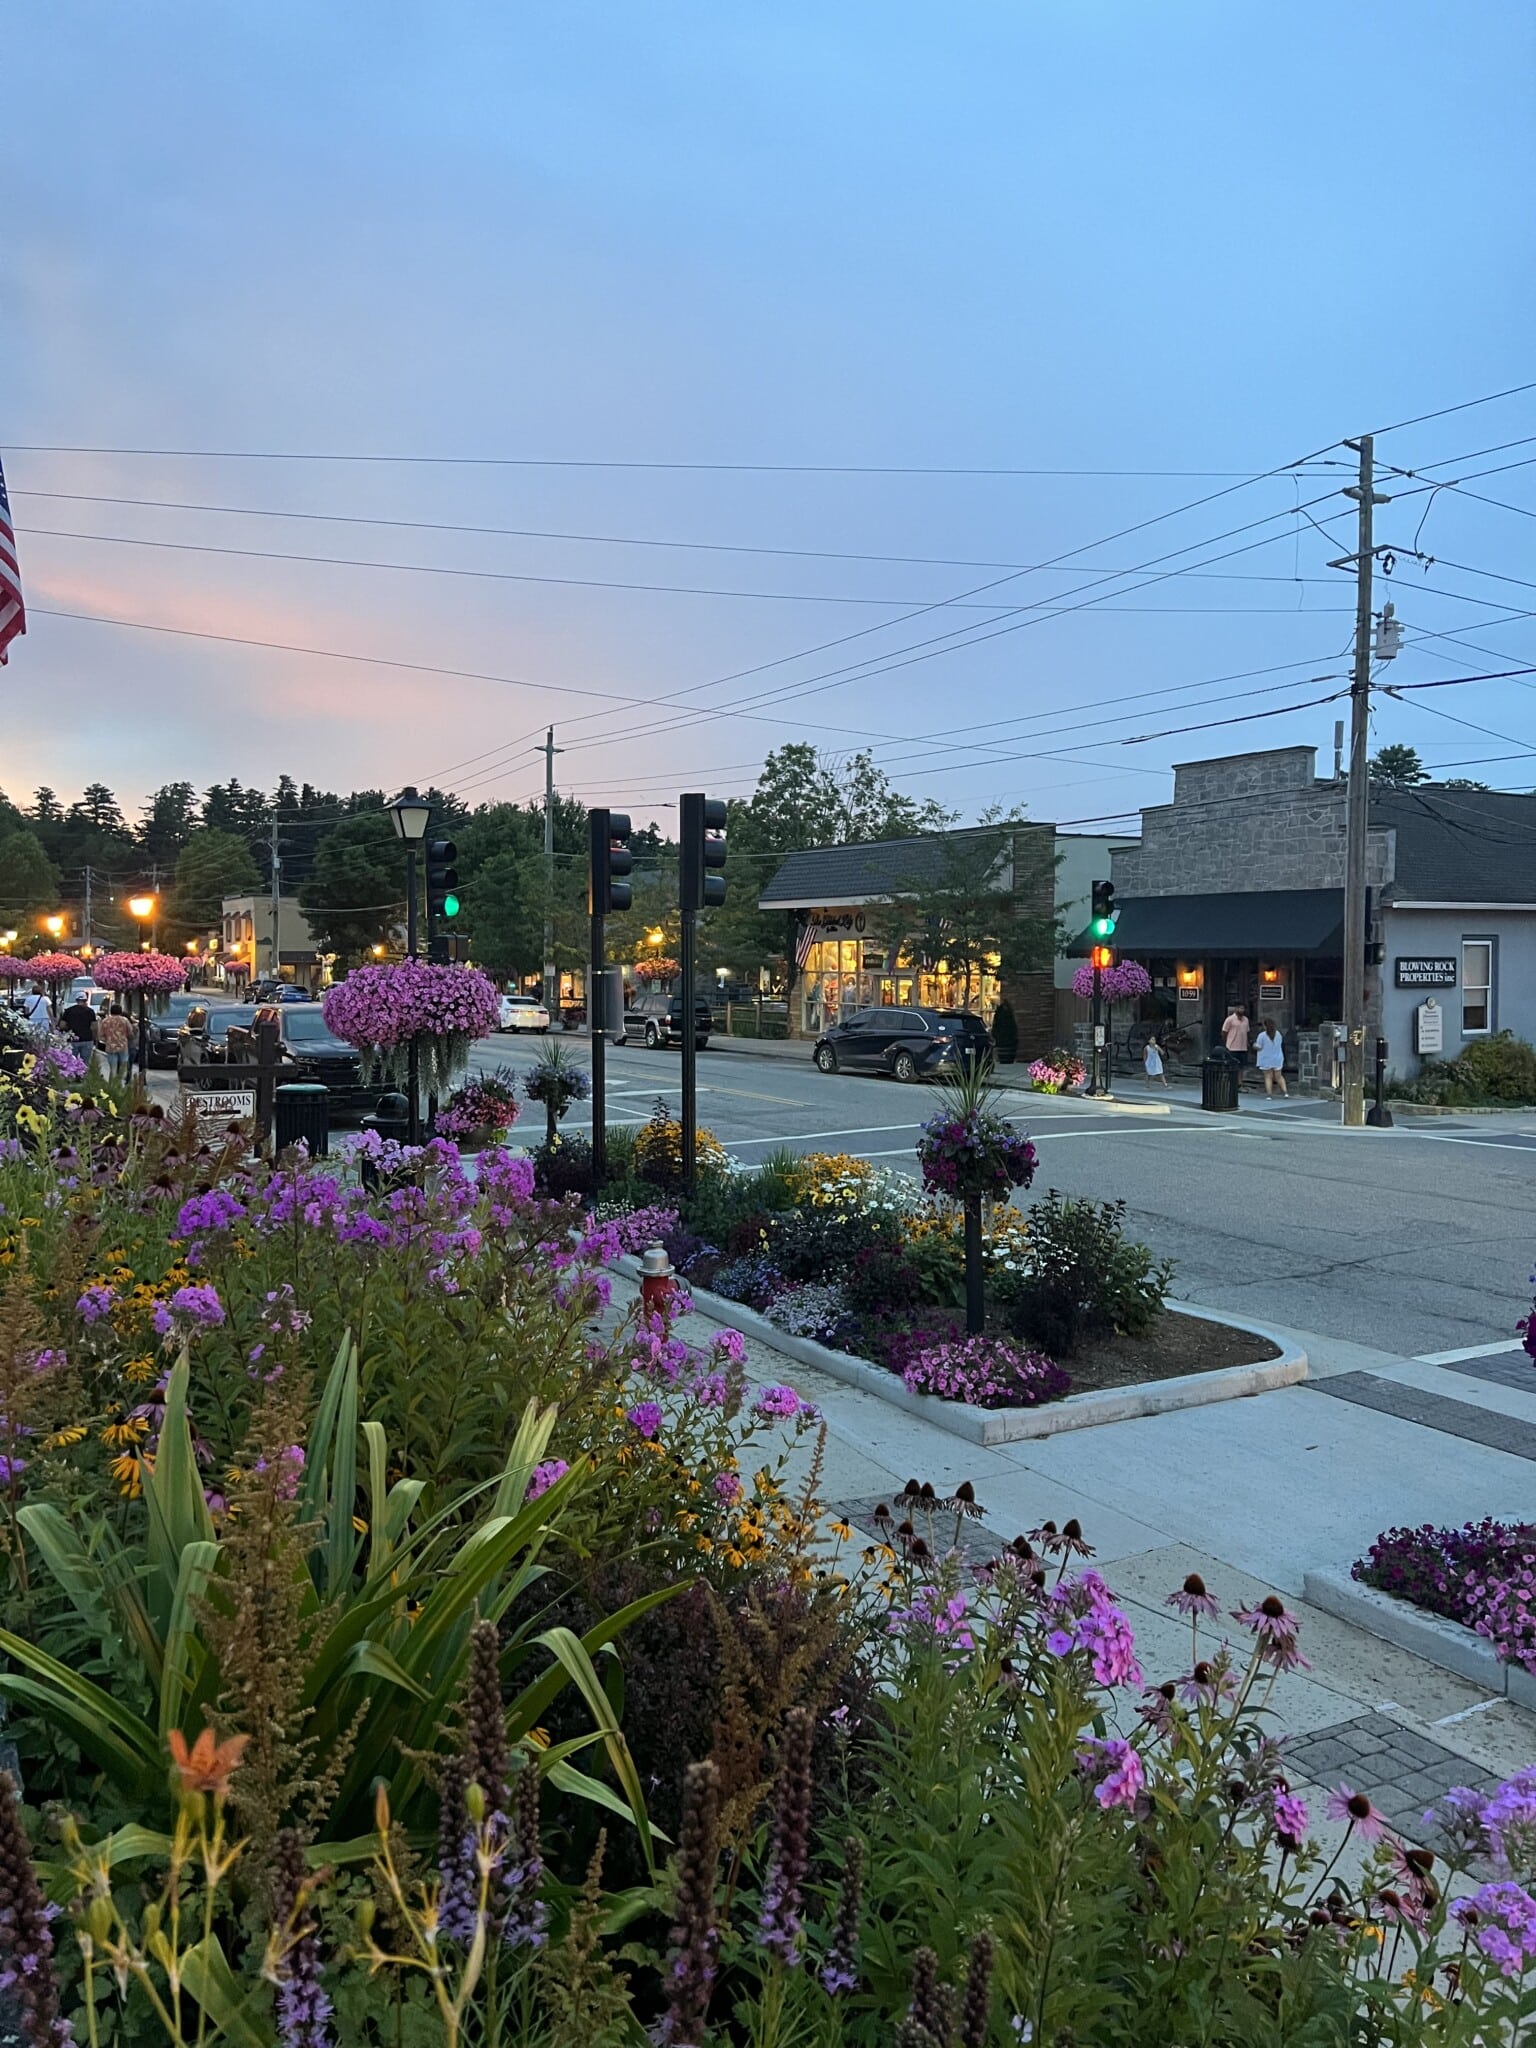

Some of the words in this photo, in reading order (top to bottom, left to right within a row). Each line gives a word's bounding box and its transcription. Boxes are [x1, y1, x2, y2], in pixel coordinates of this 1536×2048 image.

[1400, 962, 1433, 971] BLOWING
[1434, 962, 1455, 971] ROCK
[1400, 972, 1443, 982] PROPERTIES
